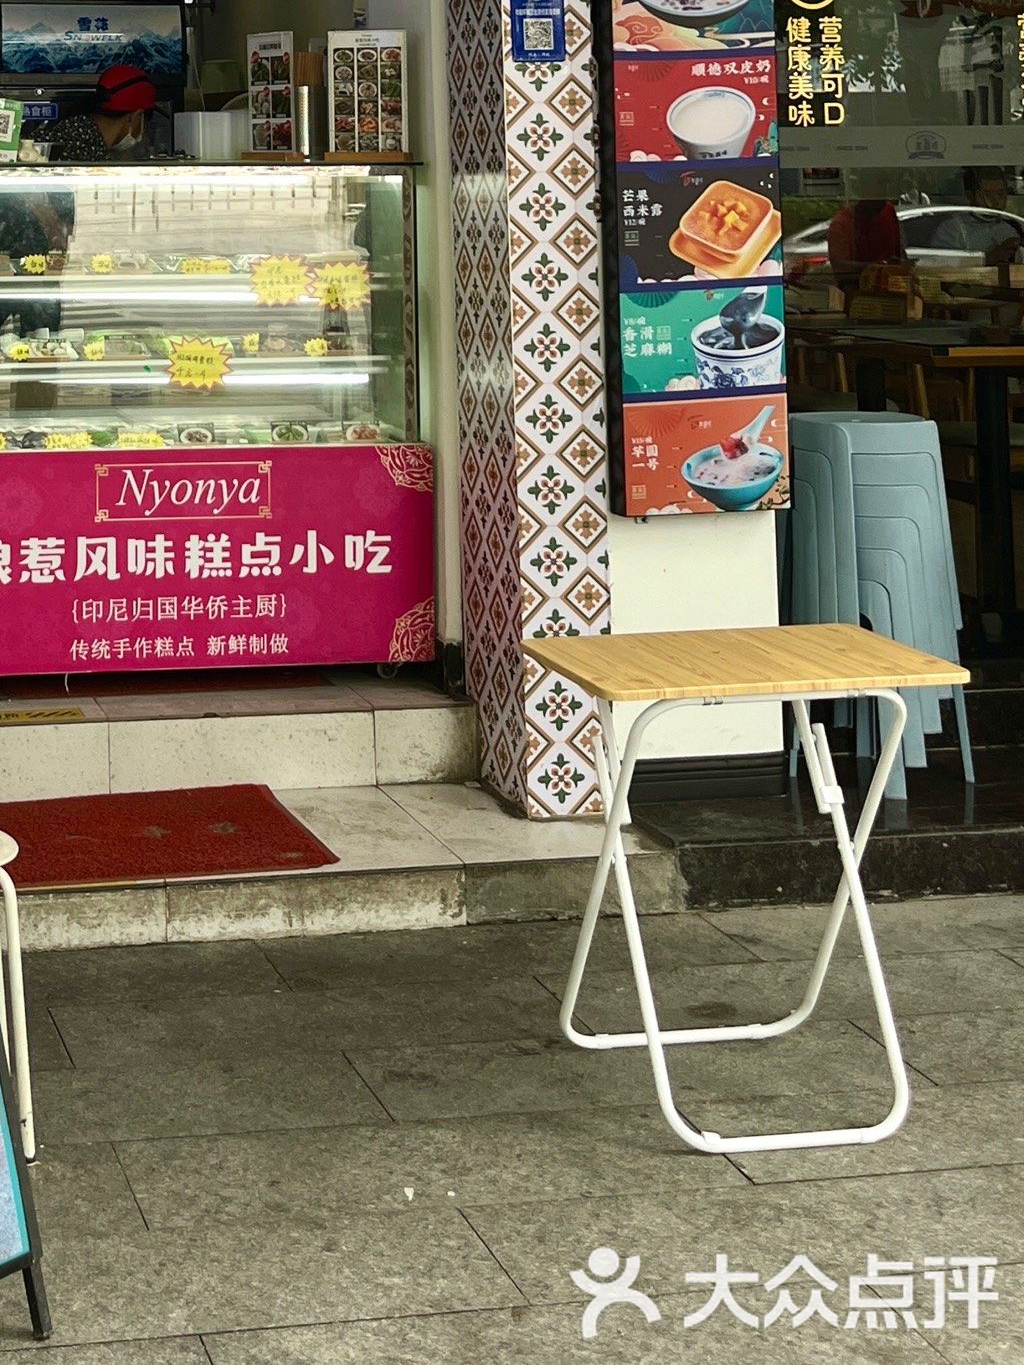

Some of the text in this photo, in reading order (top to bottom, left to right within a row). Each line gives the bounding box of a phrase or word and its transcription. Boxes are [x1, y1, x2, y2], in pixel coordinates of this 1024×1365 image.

[785, 16, 815, 127] 健康美味
[818, 15, 845, 126] 营养可口
[622, 189, 649, 202] 芒果
[115, 468, 261, 516] Nyonya
[69, 633, 289, 661] 传统手作糕点 新鲜制做
